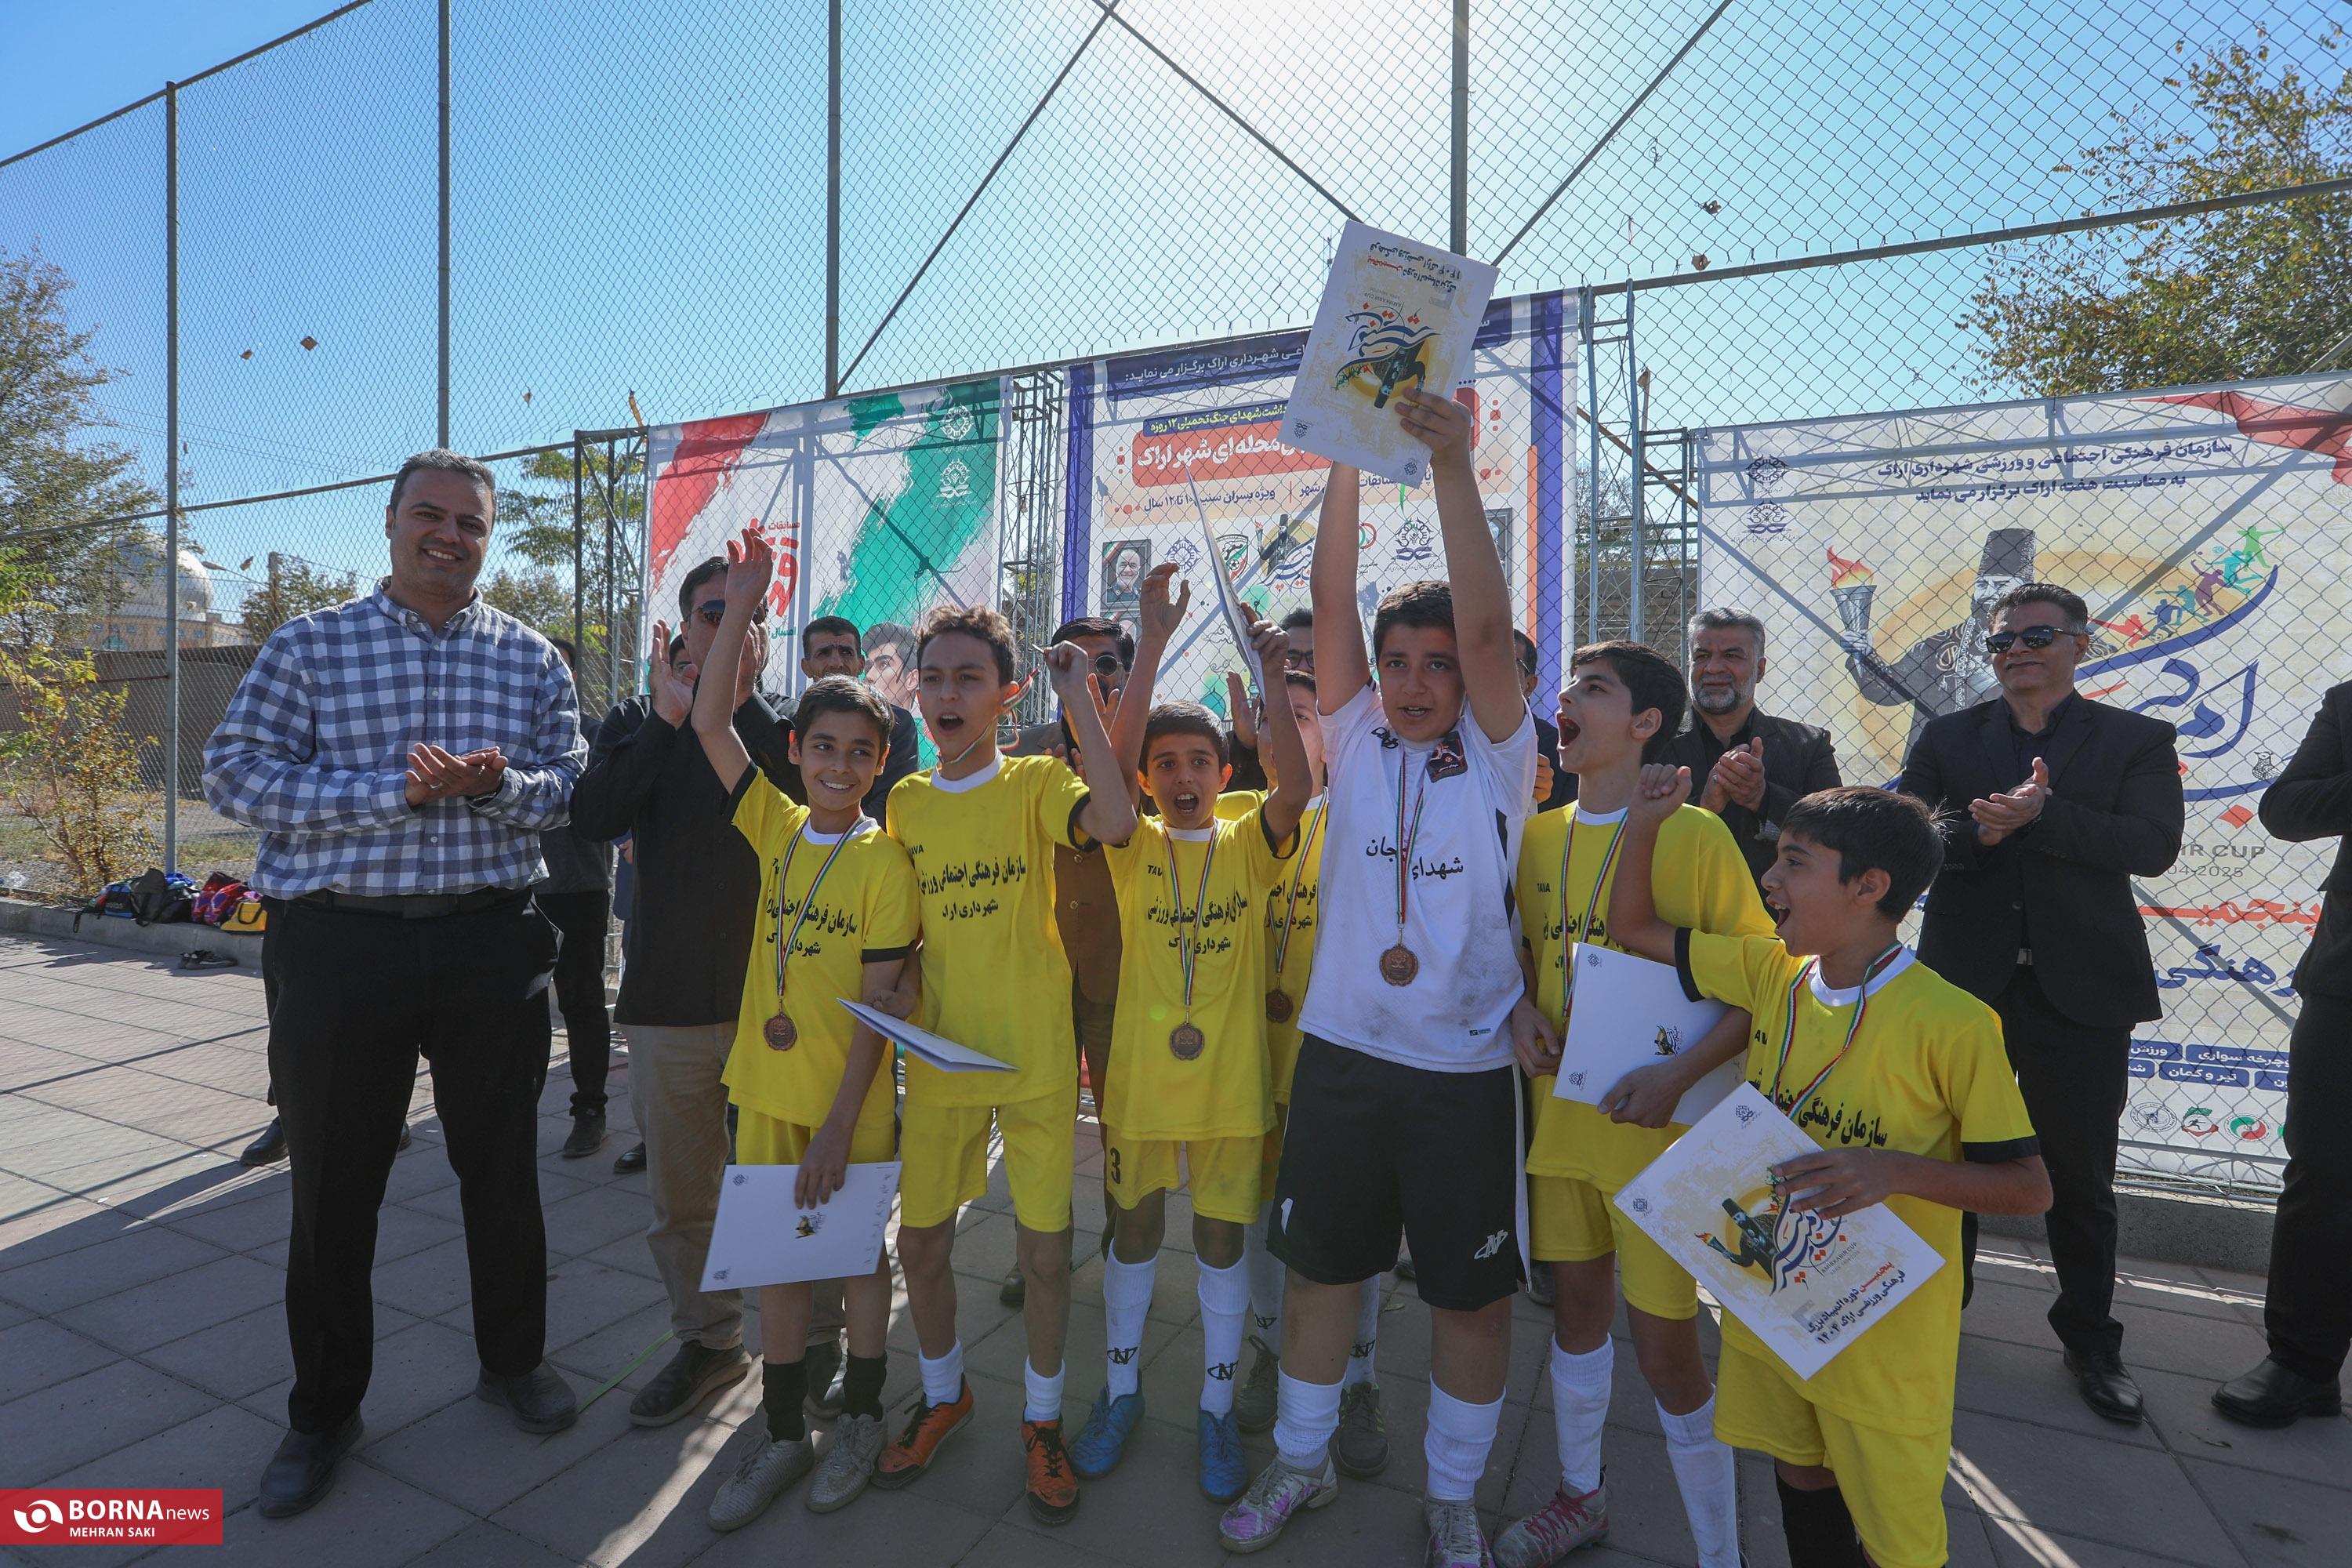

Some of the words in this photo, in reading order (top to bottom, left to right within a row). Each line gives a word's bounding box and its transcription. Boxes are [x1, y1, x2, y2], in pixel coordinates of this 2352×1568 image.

[1207, 356, 1229, 371] اراک
[1230, 348, 1279, 367] شهرداری
[1174, 359, 1206, 378] برگزار
[1210, 412, 1230, 424] جنگ
[1137, 442, 1172, 470] اراک
[1172, 437, 1213, 469] شهر
[2110, 441, 2172, 465] فرهنگی
[2175, 440, 2233, 459] سازمان
[1911, 458, 1973, 477] شهرداری
[1976, 456, 2024, 474] ورزشی
[2038, 448, 2107, 470] اجتماعی
[1878, 462, 1909, 479] اراک
[1299, 481, 1320, 498] شهر
[2023, 478, 2057, 497] اراک
[2060, 475, 2099, 492] هفته
[2102, 474, 2168, 492] مناسبت
[2171, 474, 2187, 488] به
[1221, 489, 1254, 506] پسران
[1254, 488, 1276, 503] ویژه
[1975, 482, 2020, 502] برگزار
[1144, 497, 1163, 512] سال
[2212, 844, 2266, 858] CUP
[1411, 856, 1465, 880] شهدای
[2198, 1050, 2242, 1062] سواری
[2168, 1067, 2204, 1079] کمان
[2217, 1071, 2238, 1083] تیر
[1798, 1097, 1845, 1139] فرهنگی
[1881, 1269, 1906, 1298] فرهنگی
[1840, 1311, 1857, 1327] اراک
